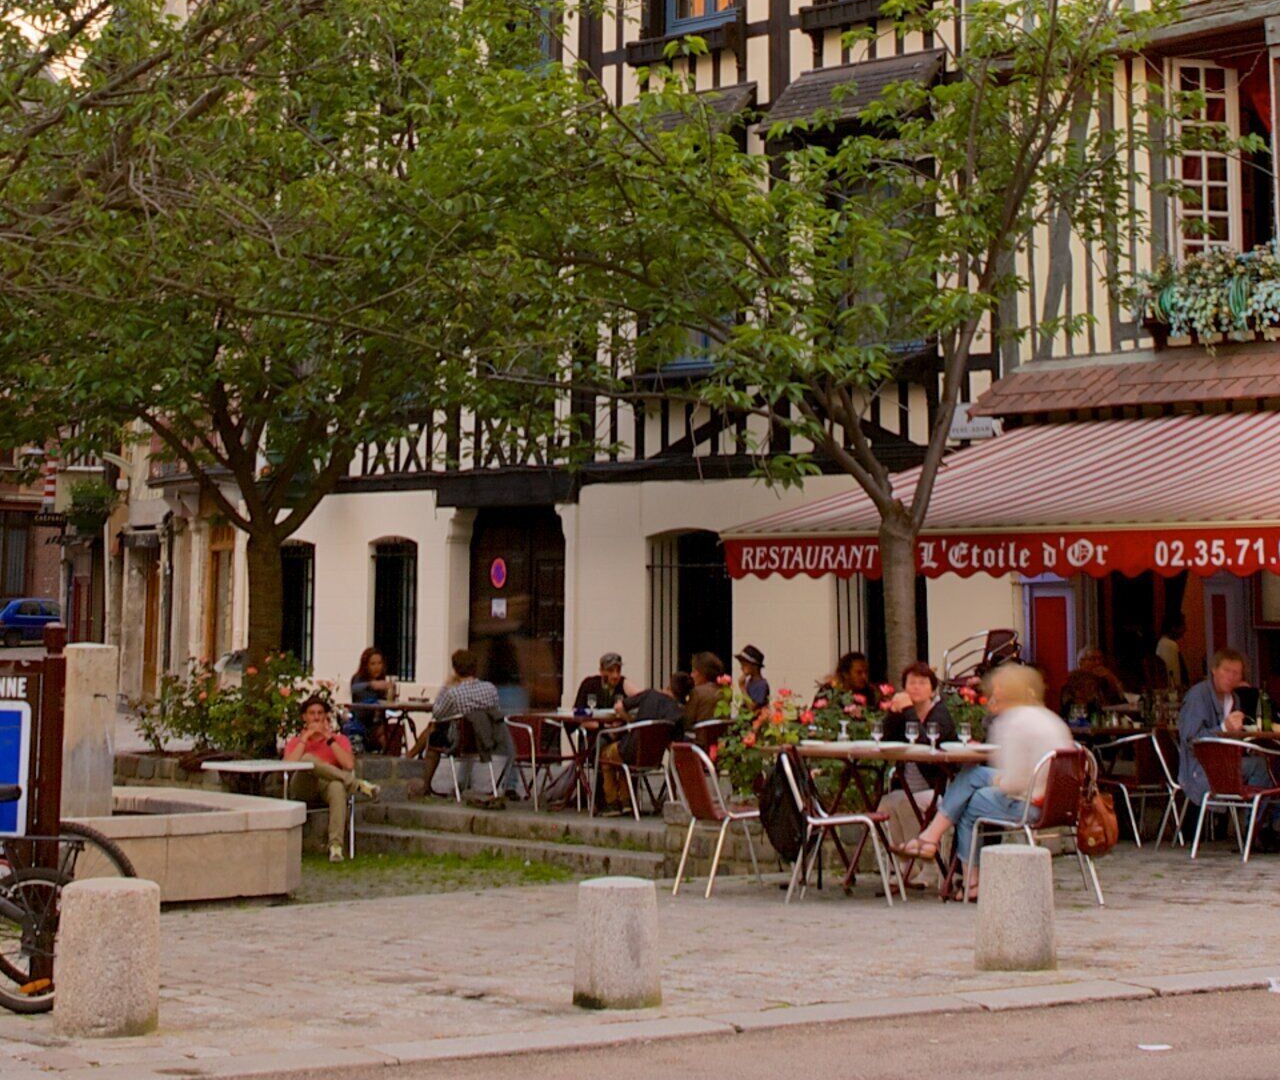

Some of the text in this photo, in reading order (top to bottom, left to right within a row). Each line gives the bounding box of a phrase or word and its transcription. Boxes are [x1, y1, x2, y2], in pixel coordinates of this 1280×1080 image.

[740, 543, 880, 571] RESTAURANT
[919, 539, 1031, 570] L'Etoile
[1042, 536, 1109, 568] d'Or
